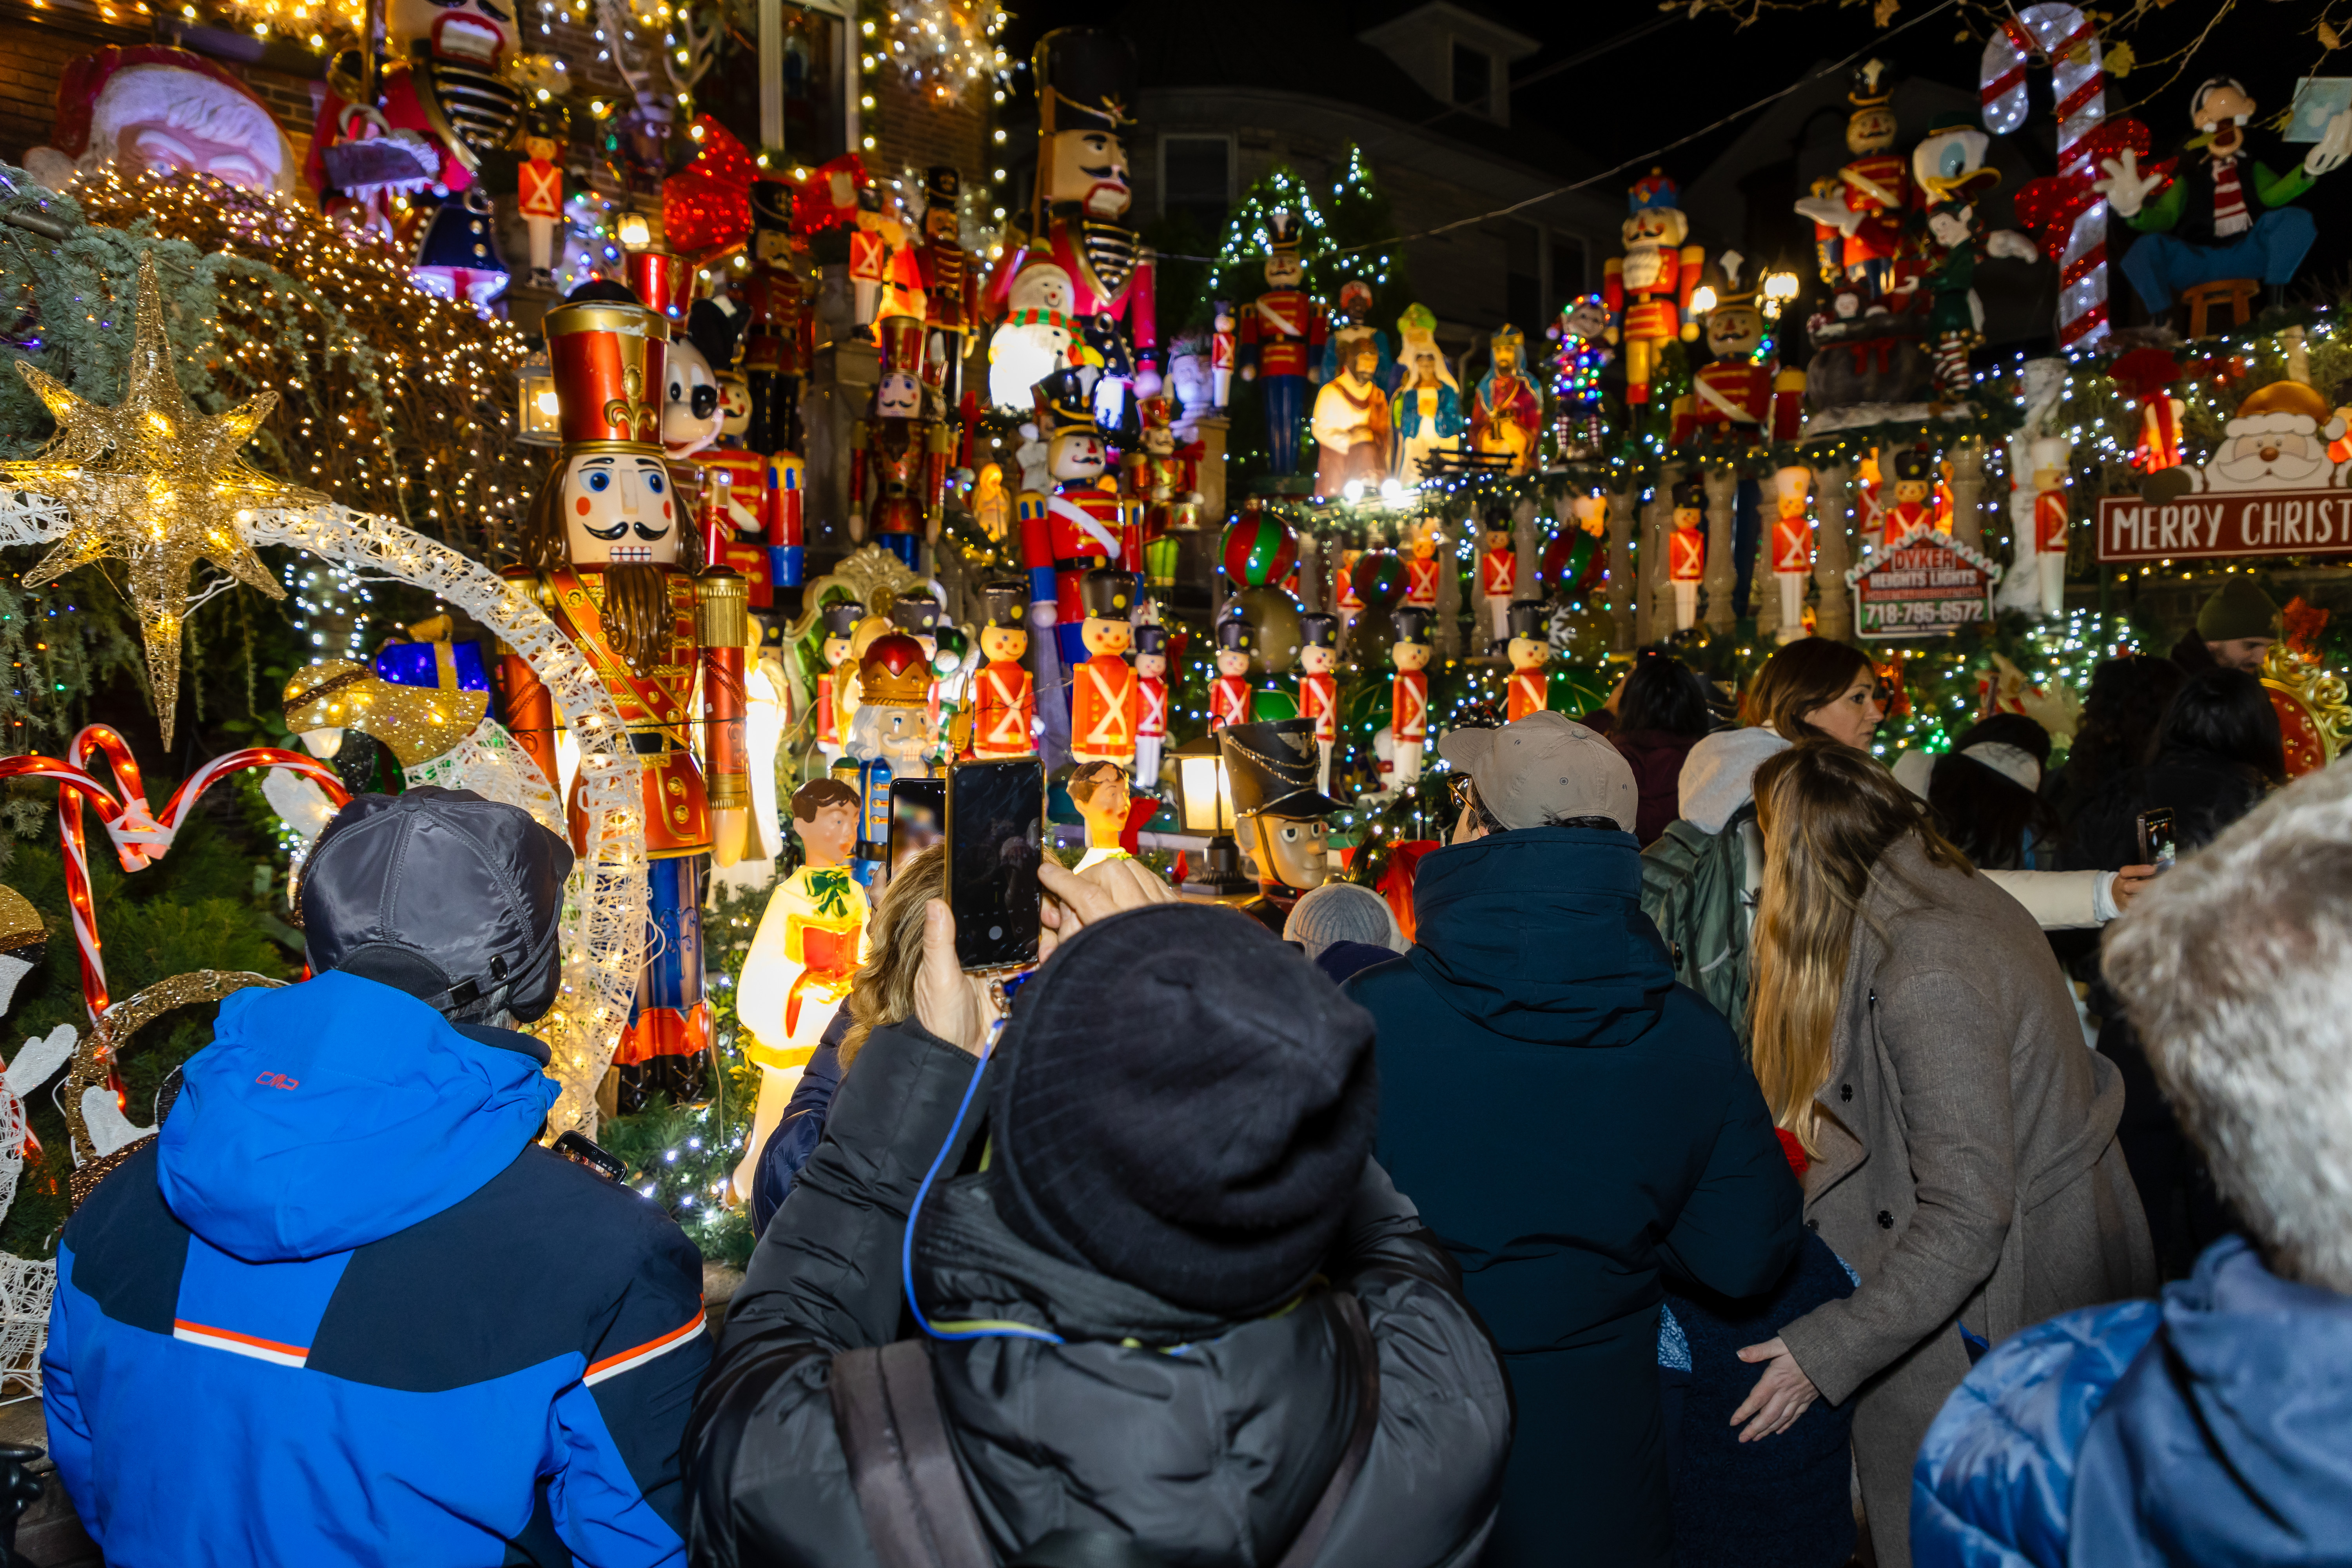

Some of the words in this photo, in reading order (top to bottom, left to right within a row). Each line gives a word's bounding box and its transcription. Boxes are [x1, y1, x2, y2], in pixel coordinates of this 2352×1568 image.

[2111, 503, 2225, 551] MERRY
[2240, 498, 2352, 546] CHRIST
[1895, 548, 1953, 569] DYKER
[1869, 571, 1927, 589] HEIGHTS
[1929, 569, 1978, 587] LIGHTS
[1864, 600, 1984, 626] 718-795-6572
